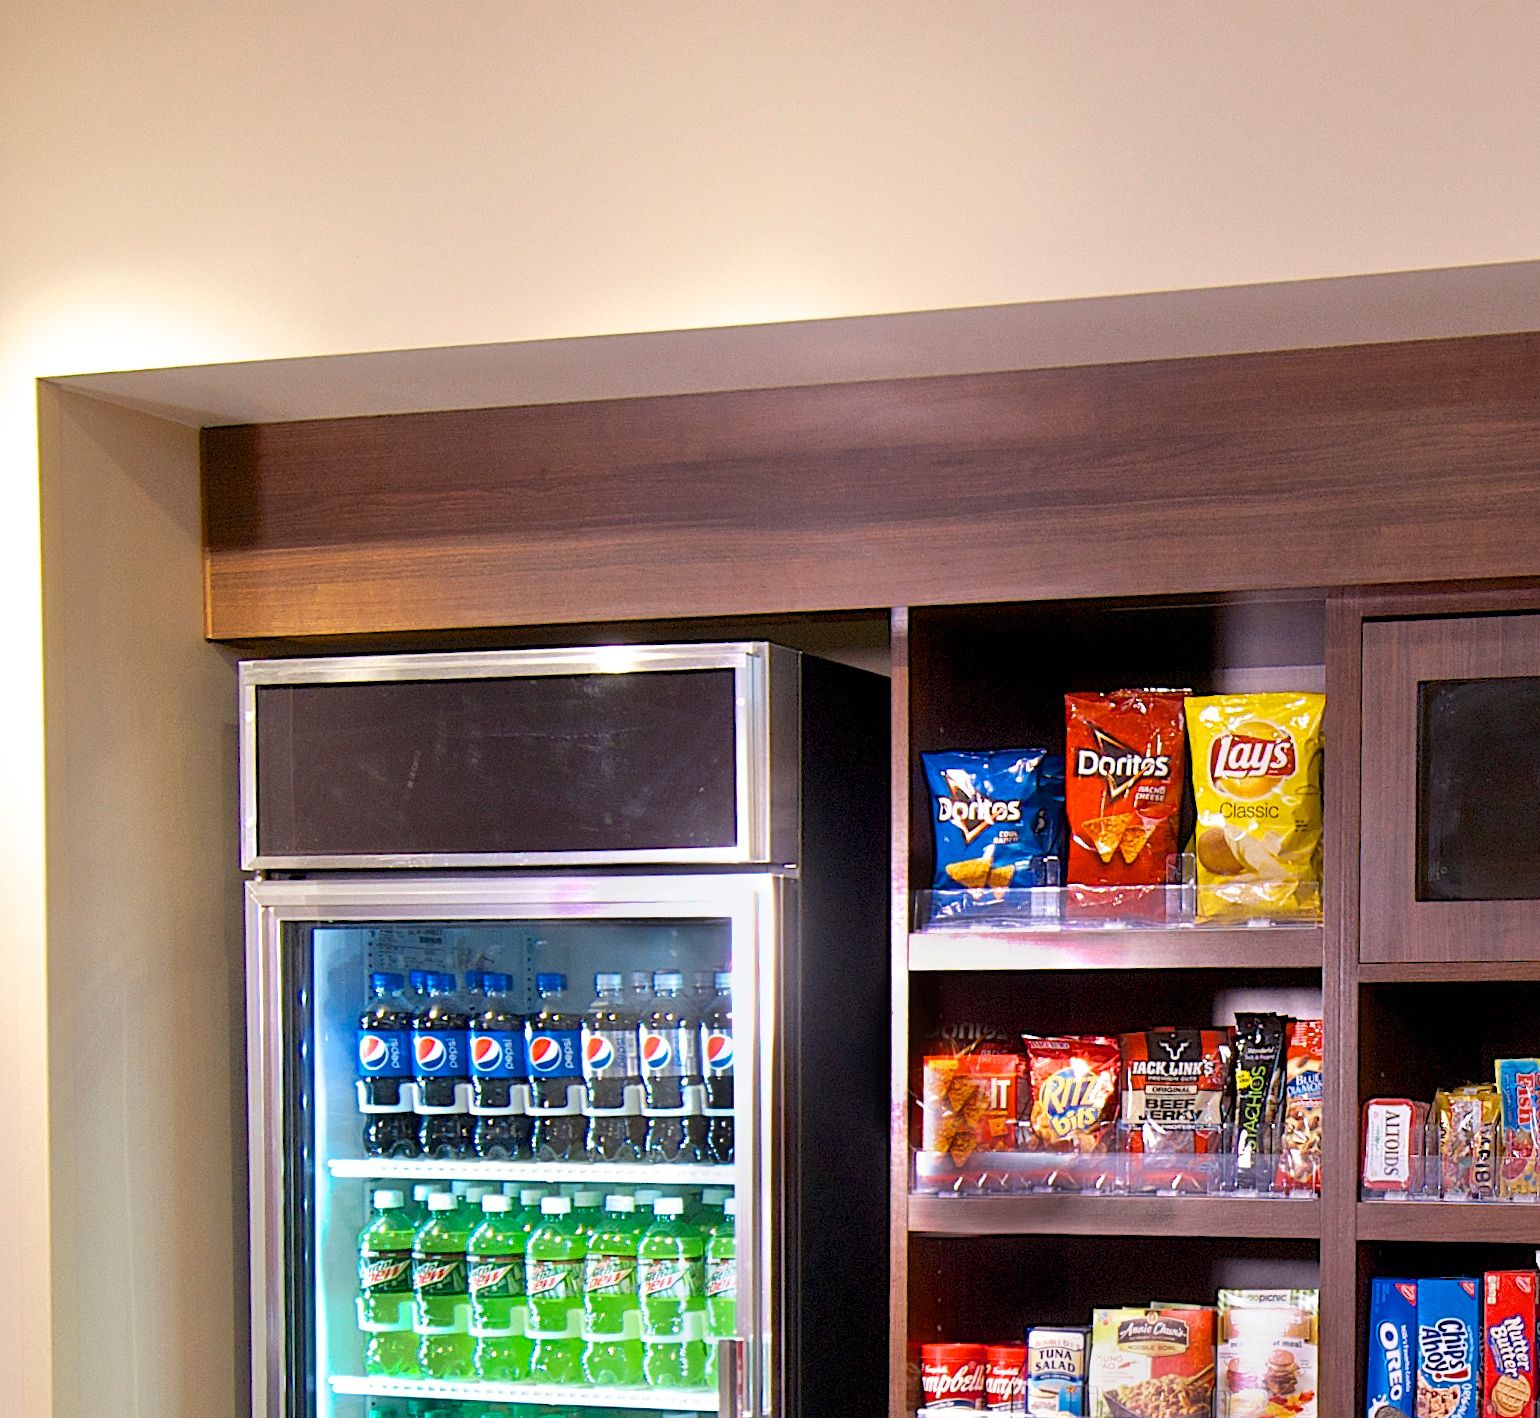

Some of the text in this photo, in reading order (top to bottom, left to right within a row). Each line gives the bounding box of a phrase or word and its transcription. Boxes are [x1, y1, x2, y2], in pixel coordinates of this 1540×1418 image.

[1077, 750, 1169, 777] Doritos
[1214, 735, 1292, 779] Lay's
[938, 796, 1021, 822] Doritos
[1135, 794, 1165, 802] CHEESE
[1220, 802, 1279, 819] Classic
[390, 1038, 400, 1069] pepsi
[447, 1037, 458, 1065] pepsi
[504, 1038, 515, 1069] pepsi
[564, 1038, 574, 1069] pepsi
[1133, 1061, 1215, 1076] JACK LINK'S
[1044, 1076, 1101, 1114] RITZ
[1145, 1099, 1196, 1109] BEEF
[1287, 1084, 1323, 1096] DIAMON
[1516, 1072, 1536, 1125] Fish
[1139, 1109, 1202, 1122] JERKY
[1383, 1109, 1400, 1177] ALTOIDS
[1119, 1322, 1185, 1338] Annie Chun's
[1437, 1319, 1467, 1369] Chips
[1504, 1316, 1531, 1372] Nutter
[1039, 1349, 1073, 1360] TUNA
[1378, 1321, 1403, 1401] OREO
[1491, 1325, 1519, 1378] Butter
[1035, 1361, 1076, 1373] SALAD
